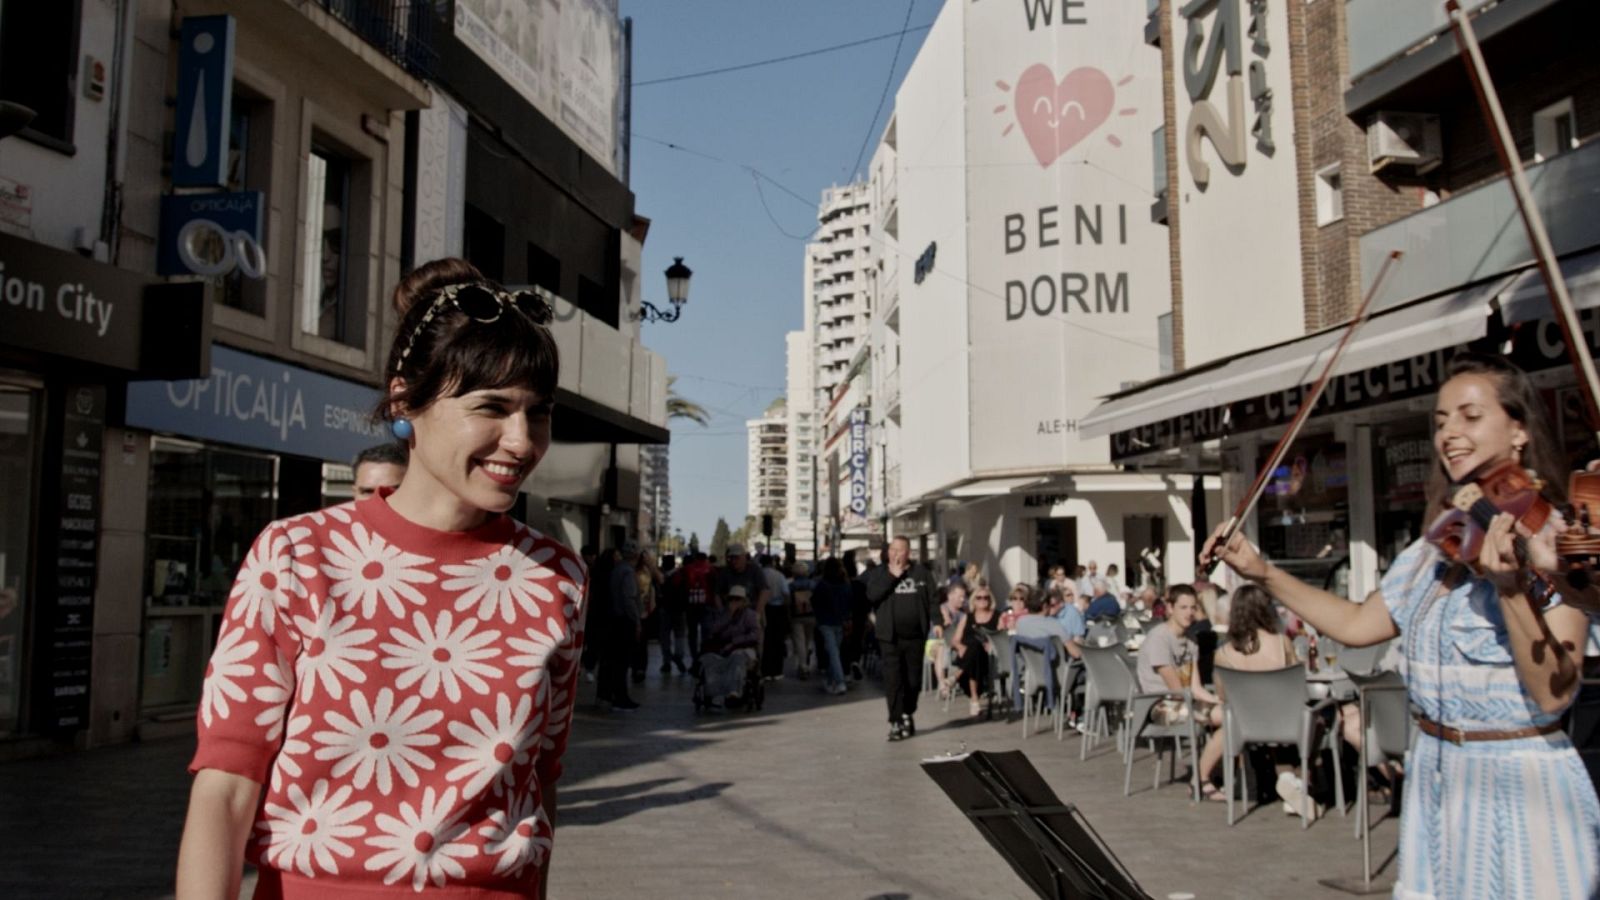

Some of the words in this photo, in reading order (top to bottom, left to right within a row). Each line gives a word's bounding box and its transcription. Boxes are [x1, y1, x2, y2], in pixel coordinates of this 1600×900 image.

[1023, 0, 1087, 31] WE
[1004, 204, 1128, 254] BENI
[56, 283, 113, 337] City
[1005, 272, 1130, 321] DORM
[851, 410, 866, 514] MERCADO
